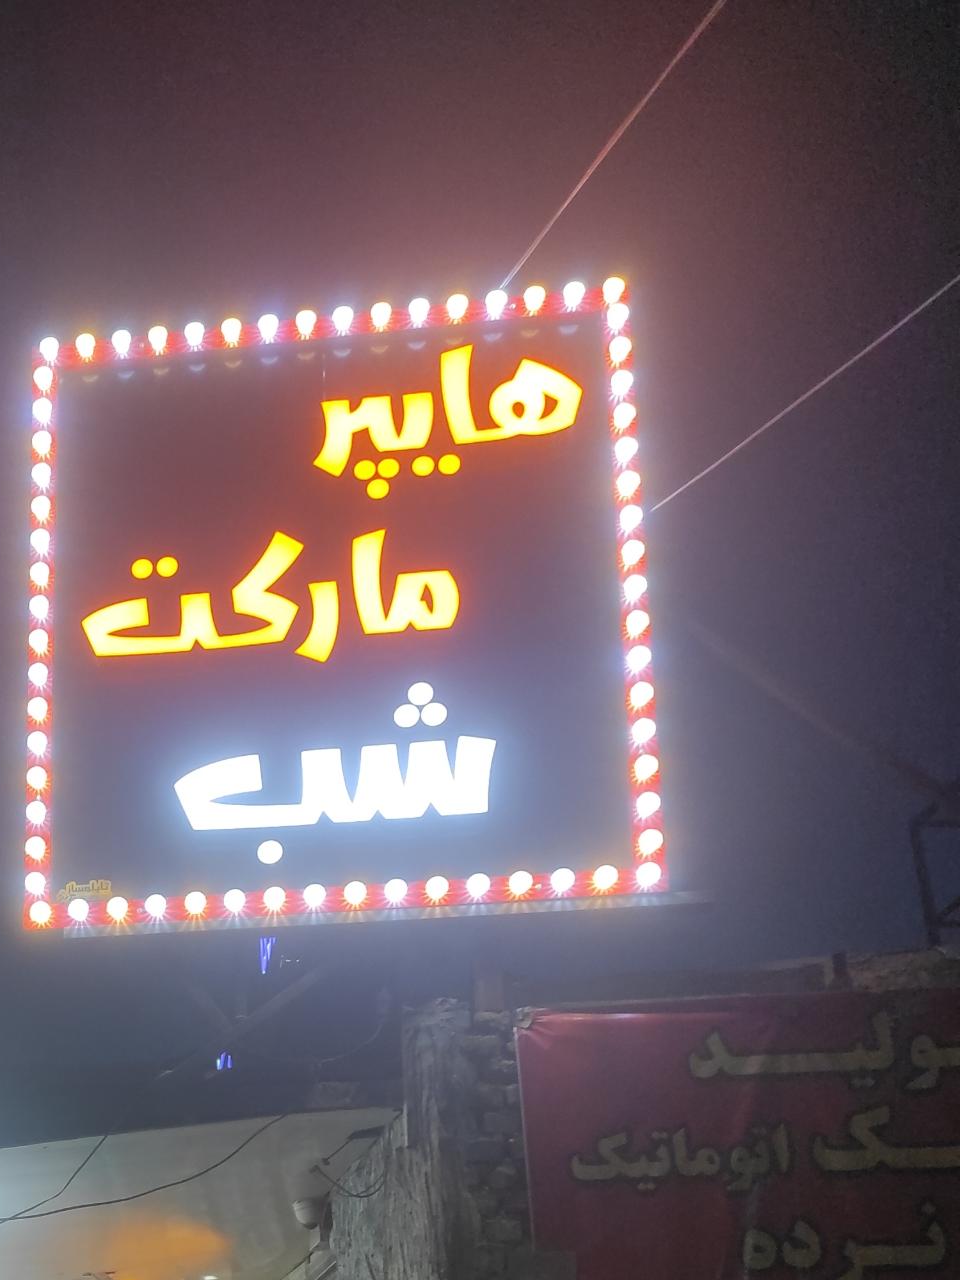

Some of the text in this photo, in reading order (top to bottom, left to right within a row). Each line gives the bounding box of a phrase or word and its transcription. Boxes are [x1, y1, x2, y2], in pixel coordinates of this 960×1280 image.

[313, 345, 583, 500] هایپر
[81, 529, 460, 663] مارکت
[173, 681, 497, 864] شب
[688, 1011, 960, 1090] ولید
[570, 1122, 792, 1191] اتوماتیک
